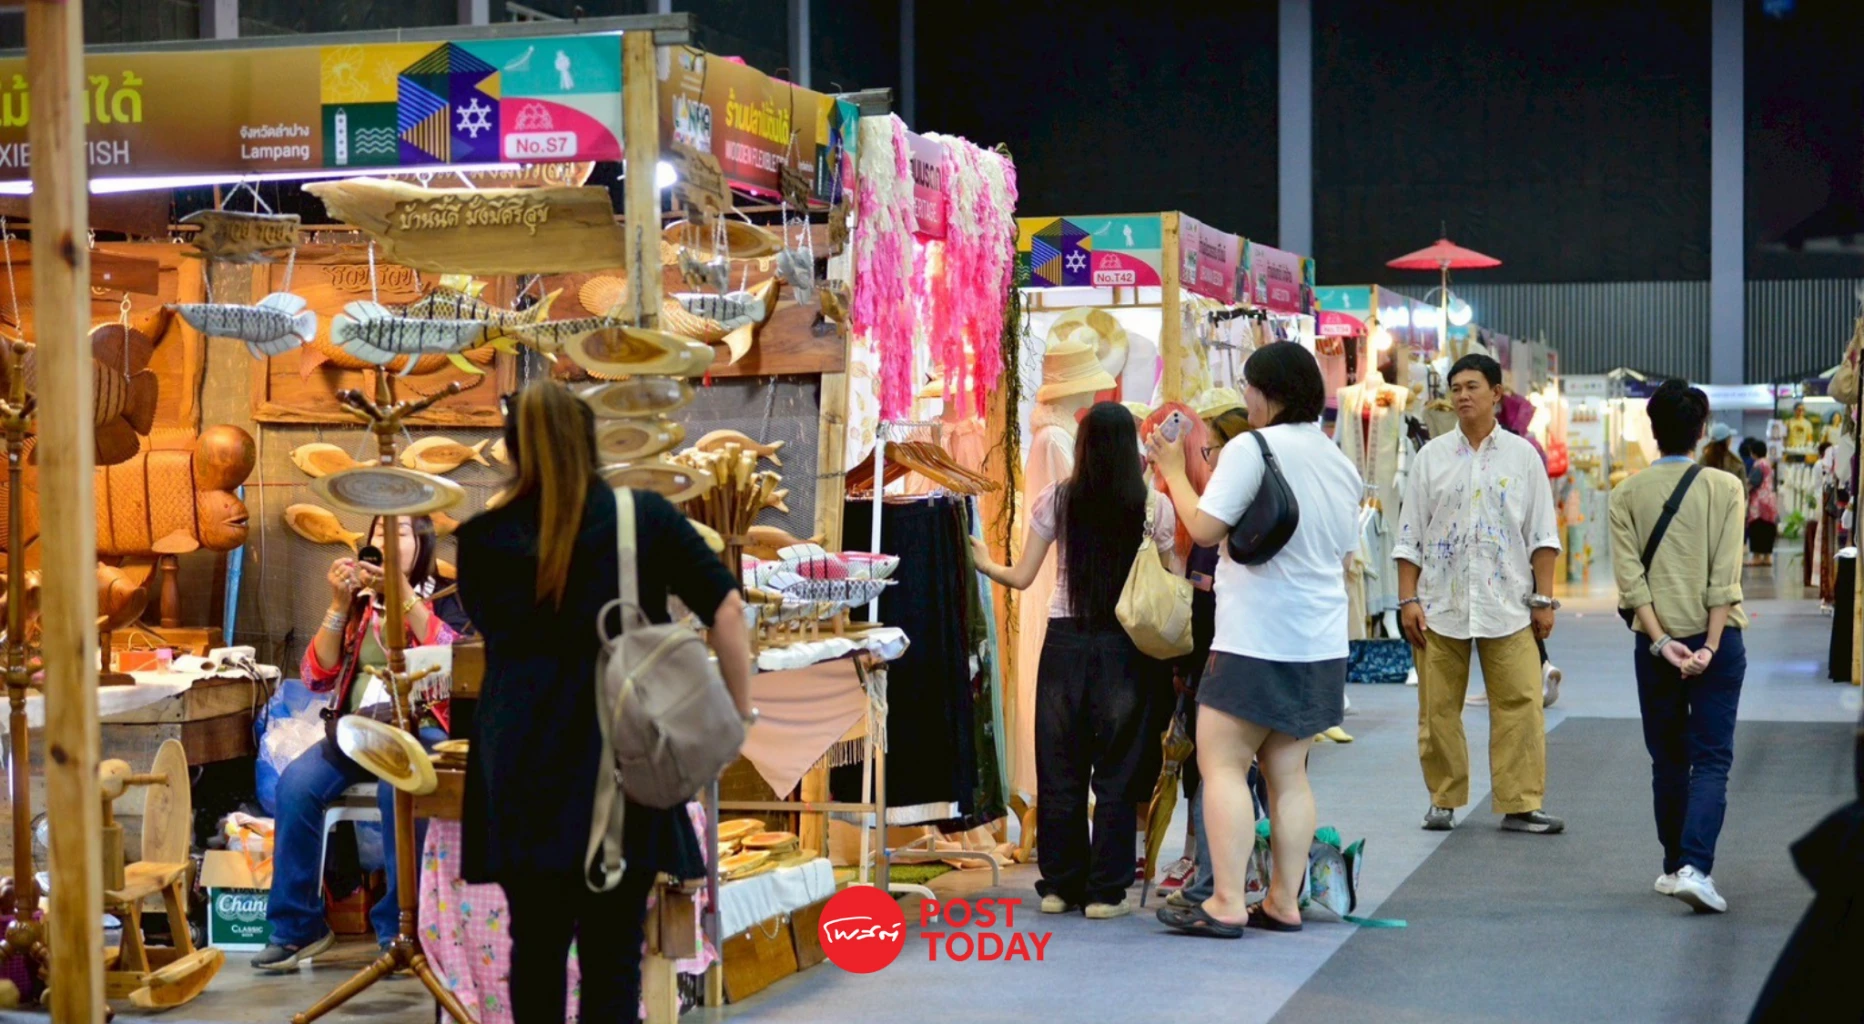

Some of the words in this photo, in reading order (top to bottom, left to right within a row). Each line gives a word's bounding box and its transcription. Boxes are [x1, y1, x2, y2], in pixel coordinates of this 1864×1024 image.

[84, 140, 130, 165] ISH
[241, 143, 310, 161] Lampang
[515, 136, 568, 153] No.S7
[1096, 272, 1133, 282] No.T42
